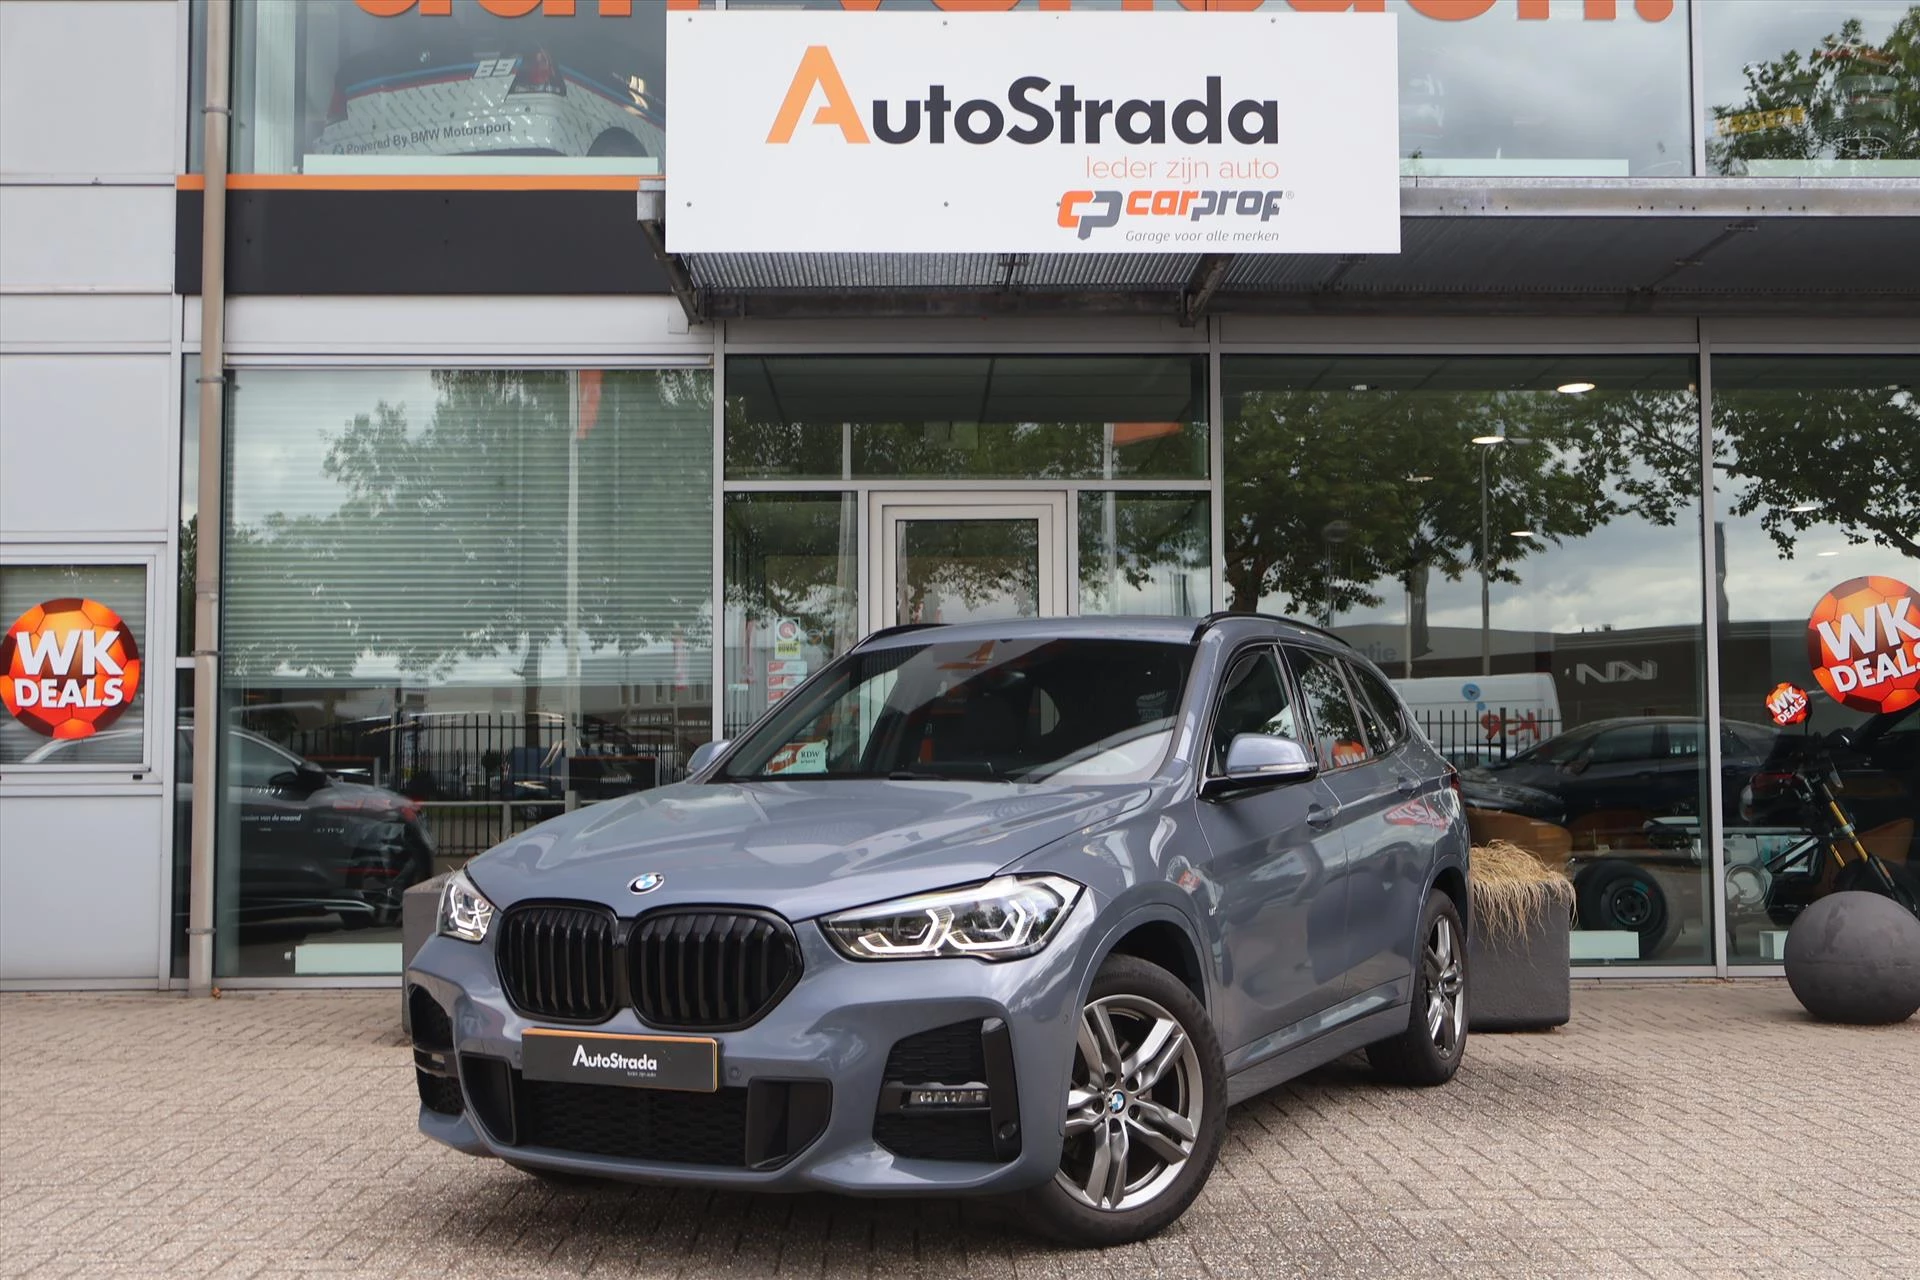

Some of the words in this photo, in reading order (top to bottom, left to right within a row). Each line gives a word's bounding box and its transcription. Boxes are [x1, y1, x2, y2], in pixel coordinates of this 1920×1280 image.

[765, 45, 1279, 145] AutoStrada
[346, 135, 391, 154] Powered
[393, 134, 408, 148] By
[410, 128, 440, 144] BMW
[443, 121, 512, 139] Motorsport
[1086, 156, 1157, 180] Ieder
[1166, 157, 1209, 184] zijn
[1219, 158, 1279, 180] auto
[1126, 190, 1283, 222] carprof
[1125, 230, 1170, 244] Garage
[1175, 232, 1202, 241] voor
[1206, 230, 1229, 241] alle
[1232, 230, 1279, 241] merken
[1817, 596, 1920, 661] WK
[16, 629, 125, 676] WK
[14, 677, 124, 708] DEALS
[1768, 686, 1801, 714] WK
[1777, 696, 1806, 723] DEALS
[572, 1044, 657, 1070] AutoStrada
